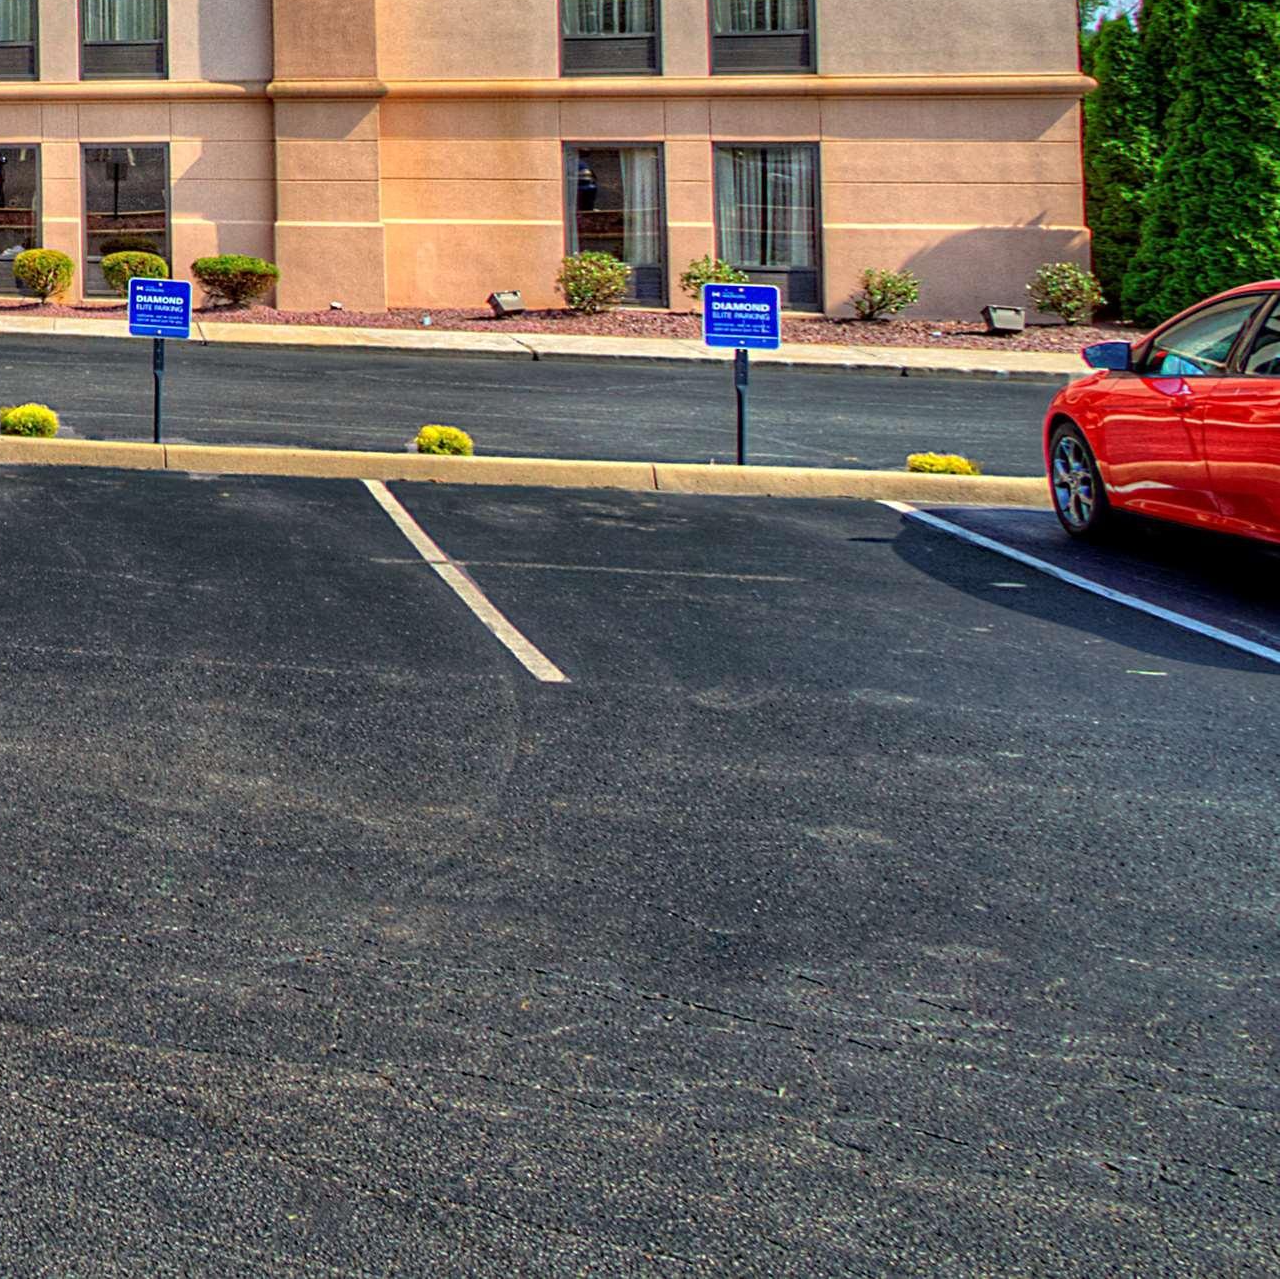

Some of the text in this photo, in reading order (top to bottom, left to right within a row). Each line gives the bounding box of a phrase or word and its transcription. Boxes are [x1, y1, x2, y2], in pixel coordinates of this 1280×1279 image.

[136, 295, 184, 305] DIAMOND
[136, 303, 184, 314] ELITE PARKING
[711, 302, 770, 312] DIAMOND
[712, 311, 770, 321] ELITE PARKING
